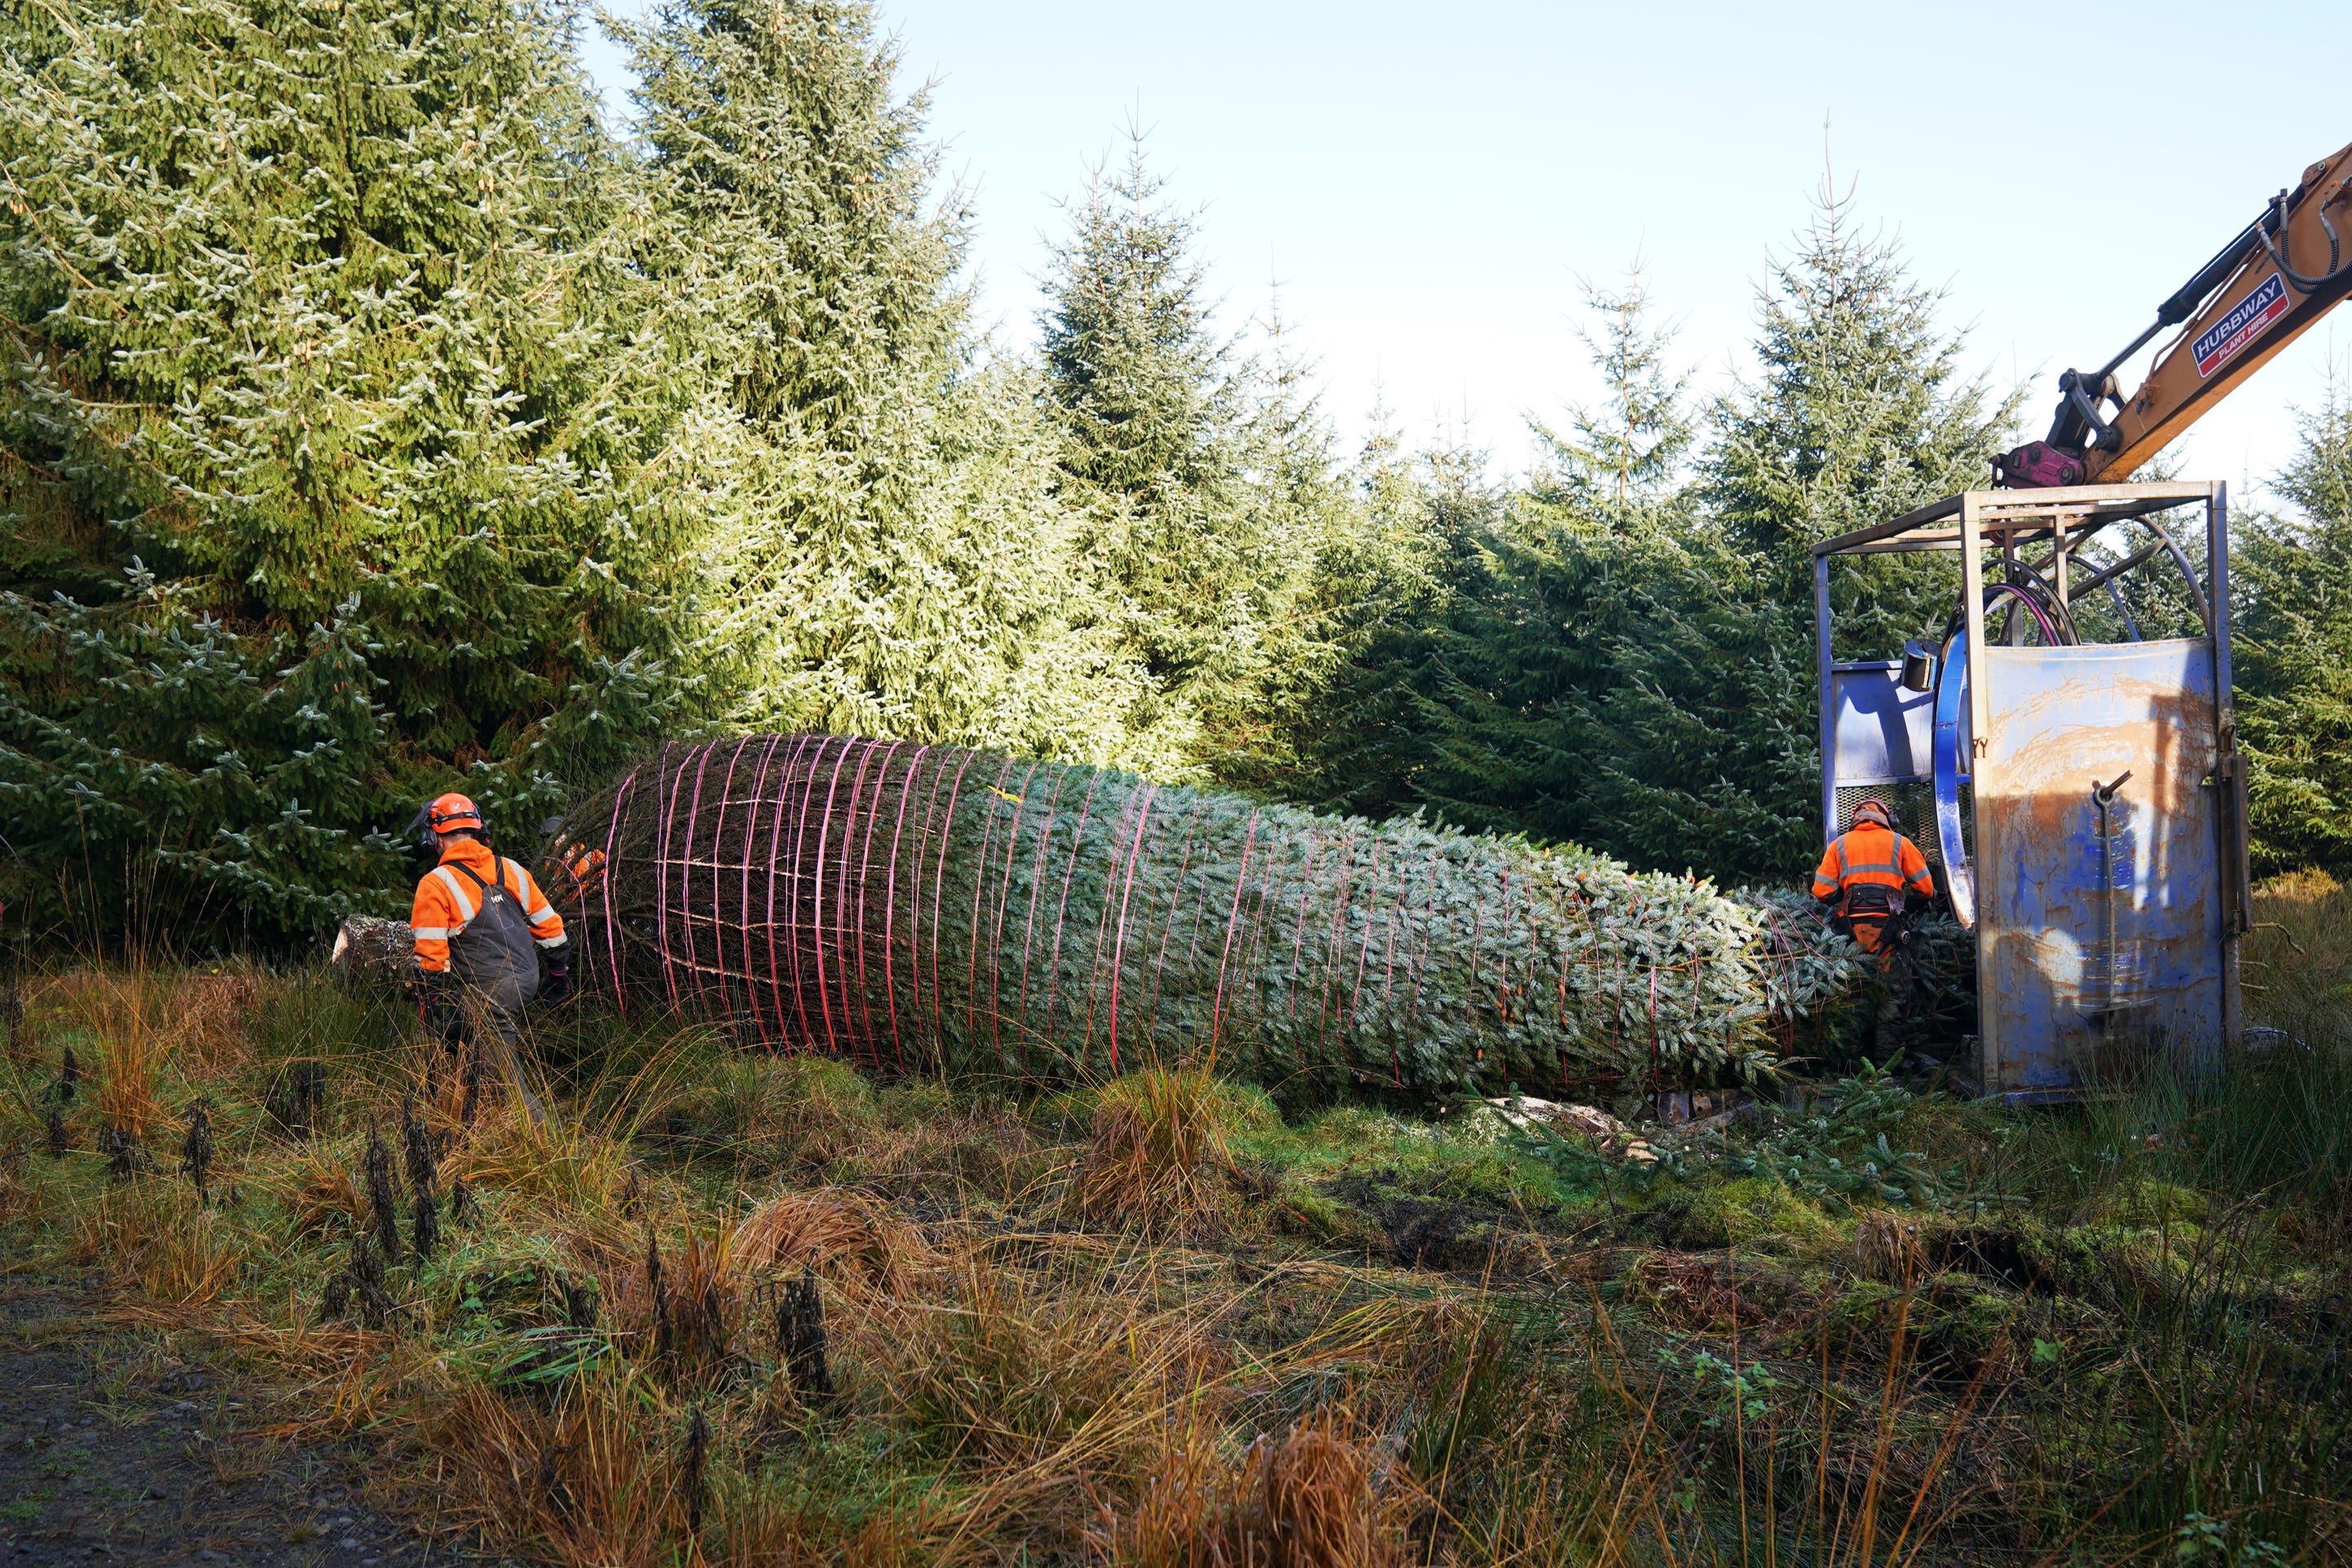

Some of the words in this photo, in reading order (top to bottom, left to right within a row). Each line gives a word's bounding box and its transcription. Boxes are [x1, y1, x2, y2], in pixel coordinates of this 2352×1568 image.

[2198, 281, 2276, 359] HUBBWAY
[2218, 330, 2246, 359] PLANT
[2247, 312, 2268, 335] HIRE
